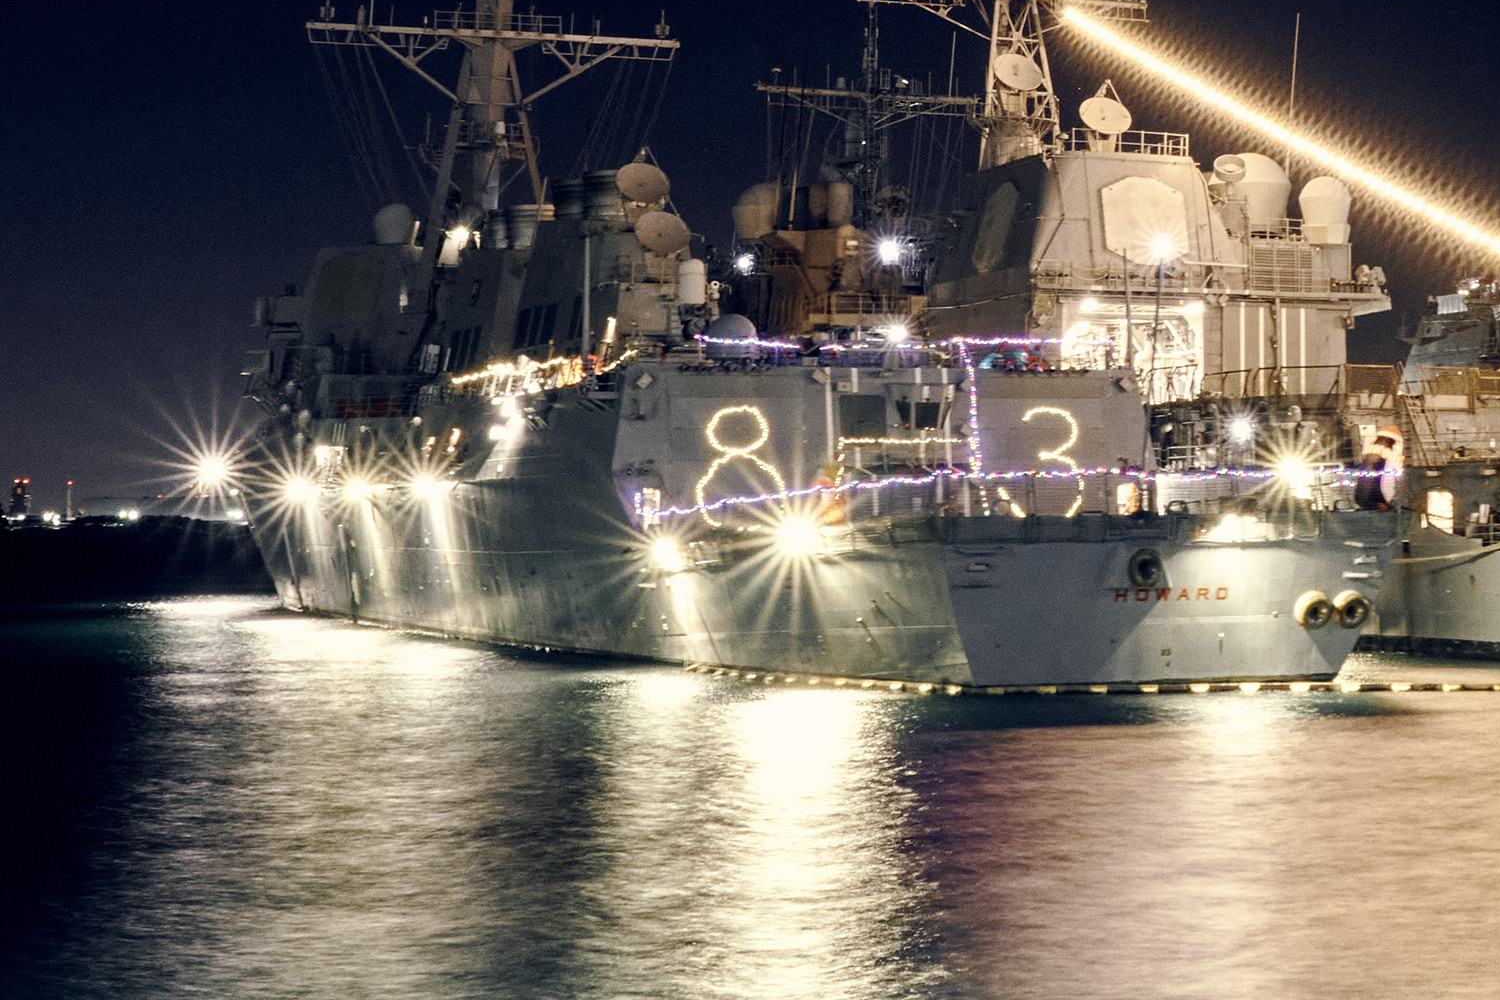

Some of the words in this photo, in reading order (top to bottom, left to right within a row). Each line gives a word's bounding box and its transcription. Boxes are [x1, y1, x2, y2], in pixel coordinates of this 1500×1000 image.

[696, 404, 788, 532] 8
[997, 405, 1086, 519] 3
[1114, 587, 1229, 602] HOWARD
